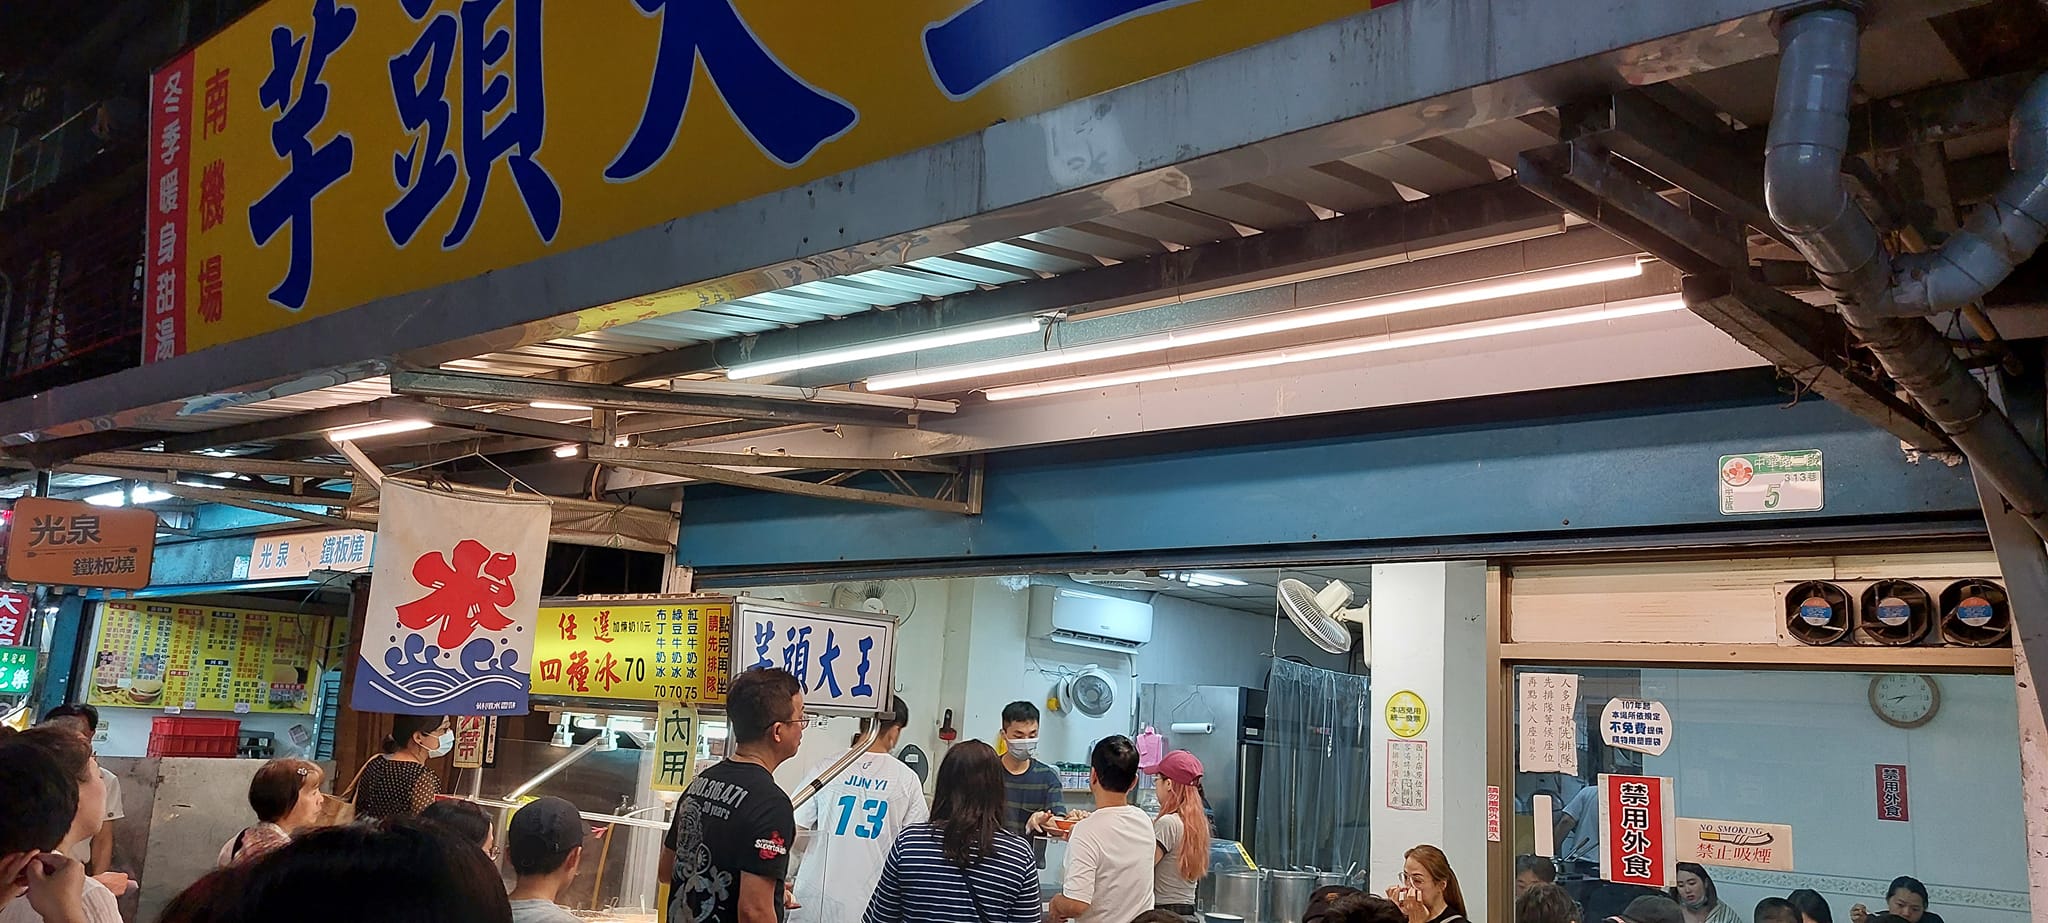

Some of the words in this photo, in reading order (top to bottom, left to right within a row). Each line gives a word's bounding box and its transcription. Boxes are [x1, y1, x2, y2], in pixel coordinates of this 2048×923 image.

[249, 0, 1195, 310] 芋頭大
[155, 70, 183, 362] 冬季暖身甜湯
[198, 67, 230, 323] 南機場
[1764, 483, 1781, 509] 5
[28, 513, 102, 547] 光泉
[259, 541, 290, 569] 光泉
[319, 534, 366, 565] 鐵板燒
[72, 556, 136, 577] 鐵板燒
[559, 610, 614, 643] 任選
[656, 609, 667, 678] 布丁牛奶冰
[671, 609, 682, 678] 綠豆牛奶冰
[686, 609, 698, 678] 紅豆牛奶冰
[540, 650, 622, 692] 四種冰
[625, 657, 645, 682] 70
[706, 615, 719, 693] 請先排隊
[717, 616, 730, 694] 點完再坐
[654, 685, 666, 698] 70
[669, 686, 682, 699] 70
[685, 686, 698, 700] 75
[1560, 678, 1573, 765] 人多時請先排隊
[660, 709, 691, 786] 內用
[844, 775, 872, 790] JUN
[875, 779, 888, 791] YI
[1883, 767, 1902, 817] 禁用外食
[835, 794, 888, 840] 13
[1621, 783, 1652, 878] 禁用外食
[1700, 823, 1714, 832] NO
[1717, 824, 1763, 835] SMOKING
[1696, 842, 1772, 865] 禁止吸煙
